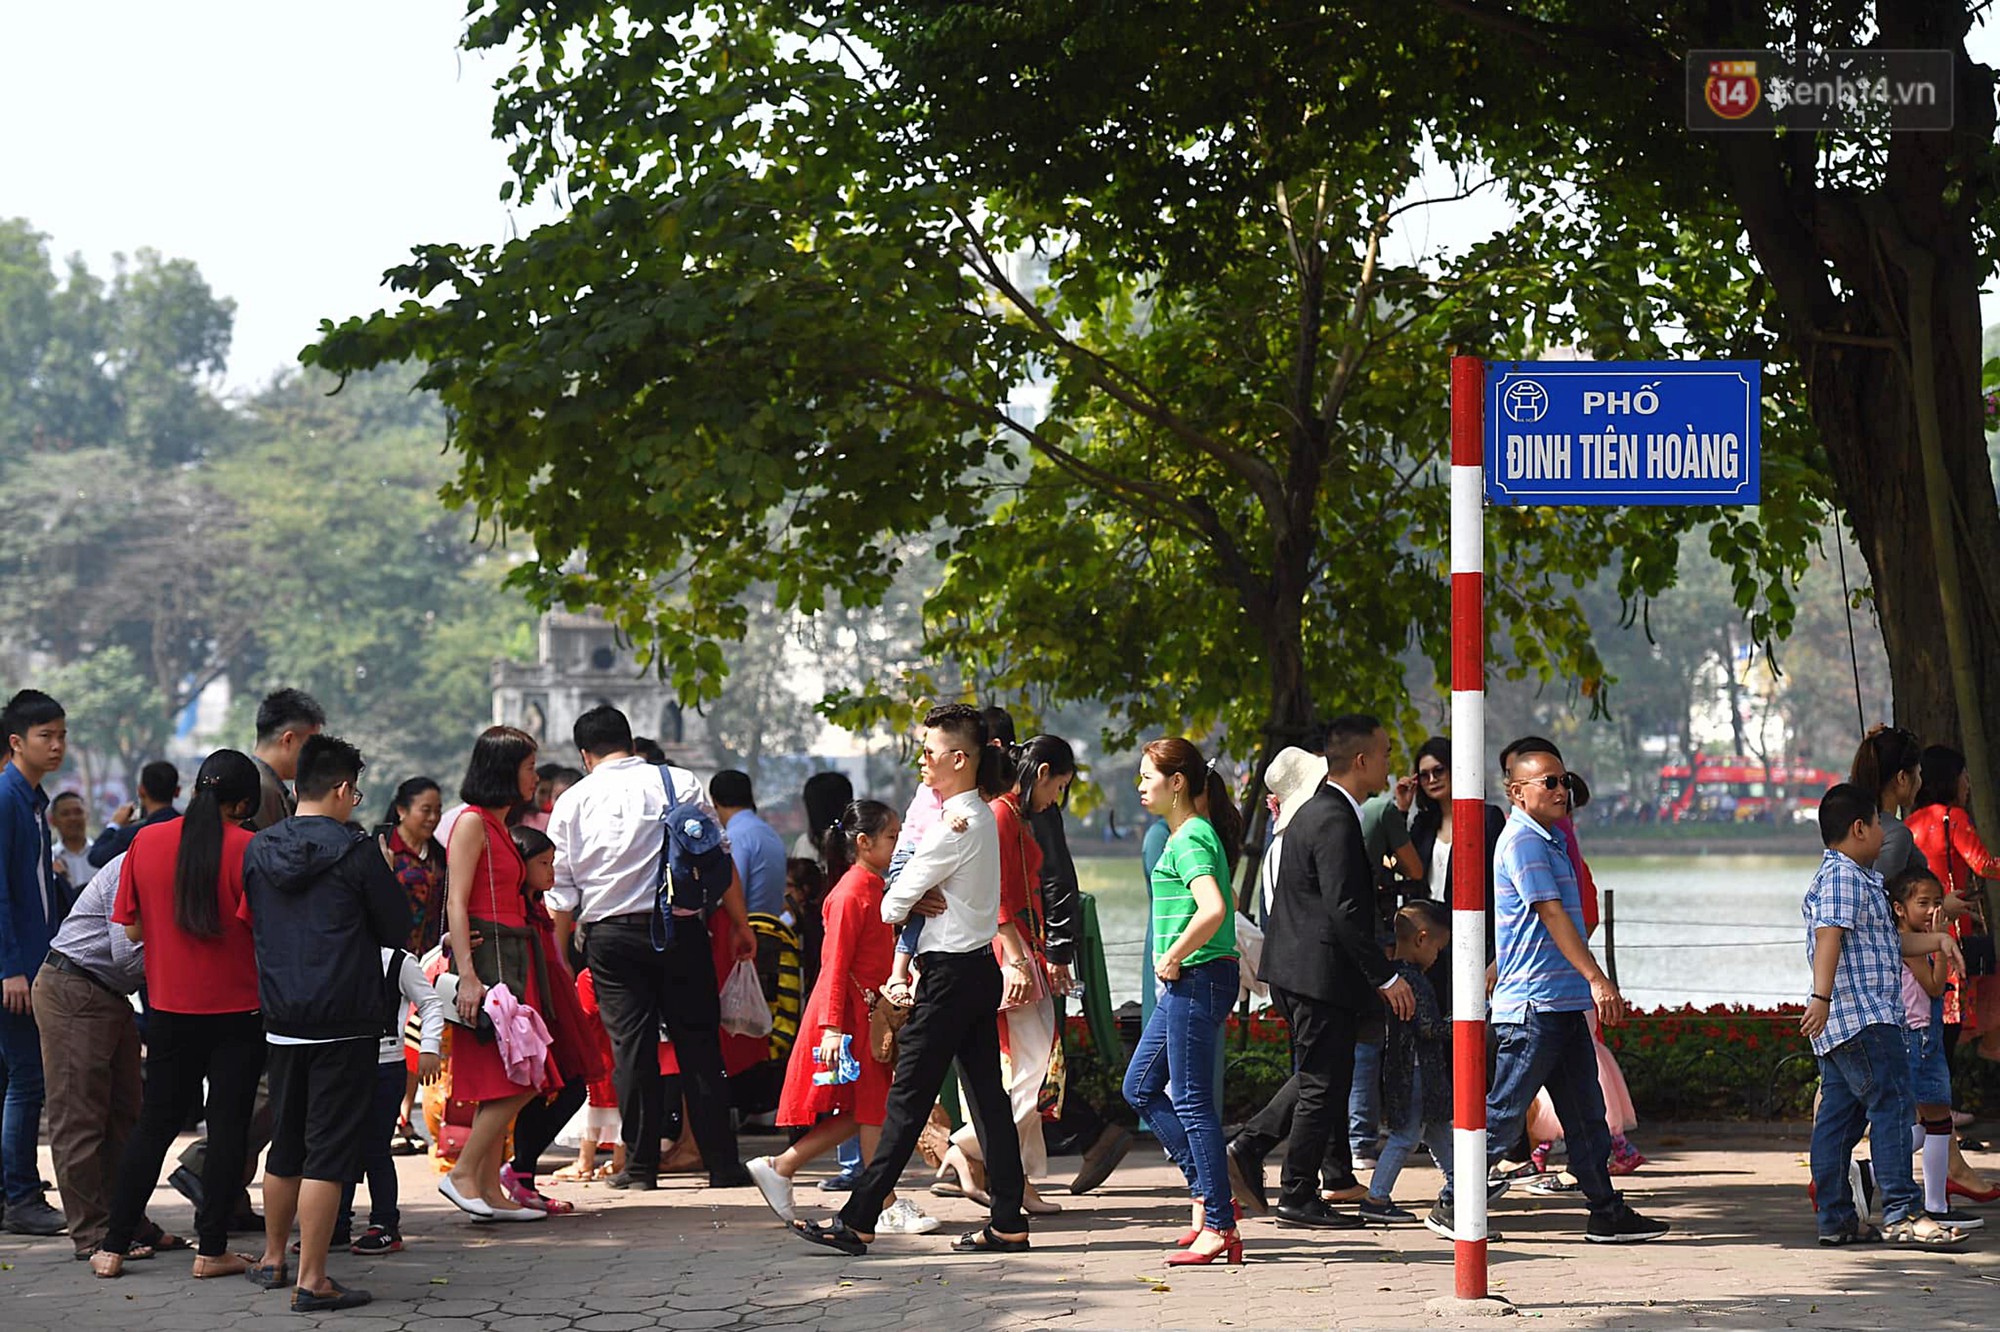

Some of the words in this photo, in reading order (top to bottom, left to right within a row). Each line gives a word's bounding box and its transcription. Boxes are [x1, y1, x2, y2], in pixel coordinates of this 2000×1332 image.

[1583, 381, 1662, 415] PHỐ
[1506, 434, 1571, 479] ĐINH
[1579, 424, 1638, 479] TIÊN
[1646, 423, 1738, 479] HOÀNG
